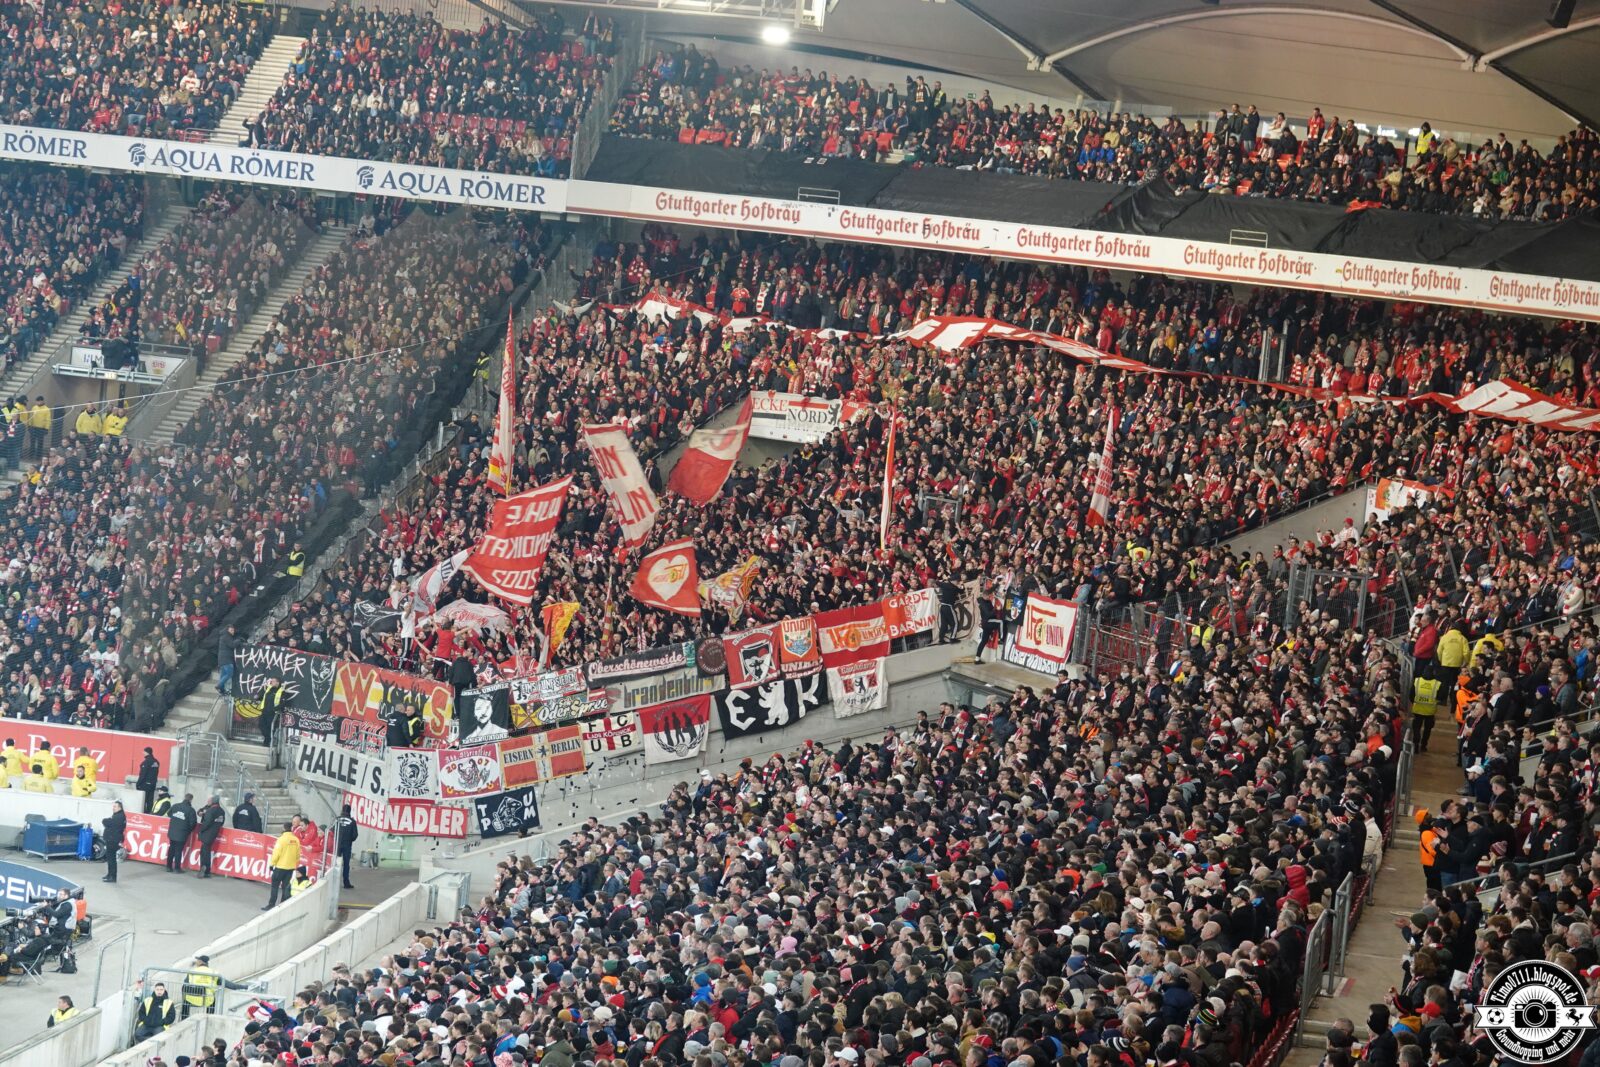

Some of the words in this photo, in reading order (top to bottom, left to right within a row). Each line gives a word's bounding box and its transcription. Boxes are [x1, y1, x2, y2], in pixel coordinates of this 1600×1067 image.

[3, 130, 88, 159] RÖMER
[152, 148, 222, 173] AQUA
[230, 152, 315, 182] RÖMER
[379, 170, 452, 196] AQUA
[460, 175, 546, 205] RÖMER
[655, 191, 737, 218] Stuttgarter
[740, 199, 801, 223] Hofbräu
[839, 209, 919, 237] Stuttgarter
[922, 219, 981, 242] Hofbräu
[1016, 227, 1091, 253] Stuttgarter
[1094, 234, 1151, 259] Hofbräu
[1184, 244, 1255, 272] Stuttgarter
[1258, 252, 1312, 276] Hofbräu
[1342, 260, 1409, 287] Stuttgarter
[1411, 267, 1461, 292] Hofbräu
[1490, 275, 1551, 303] Stuttgarter
[1554, 283, 1600, 307] Hofbräu
[752, 397, 787, 412] ECKE
[788, 408, 828, 424] NORD
[888, 591, 929, 608] GARDE
[783, 618, 812, 633] UNION
[889, 614, 936, 637] BARNIM
[233, 647, 306, 678] HAMMER
[588, 651, 688, 677] Oberschöneweide
[239, 673, 301, 701] HEATS
[337, 662, 378, 717] W
[430, 686, 451, 737] S
[538, 701, 571, 723] Oder
[569, 697, 608, 718] Spree
[725, 690, 756, 731] E
[793, 673, 819, 718] K
[617, 714, 628, 727] C
[396, 752, 431, 762] SIXTY
[503, 748, 534, 764] EISERN
[550, 738, 581, 755] BERLIN
[590, 738, 601, 752] U
[621, 734, 632, 748] B
[298, 744, 359, 786] HALLE
[394, 784, 430, 797] NINERS
